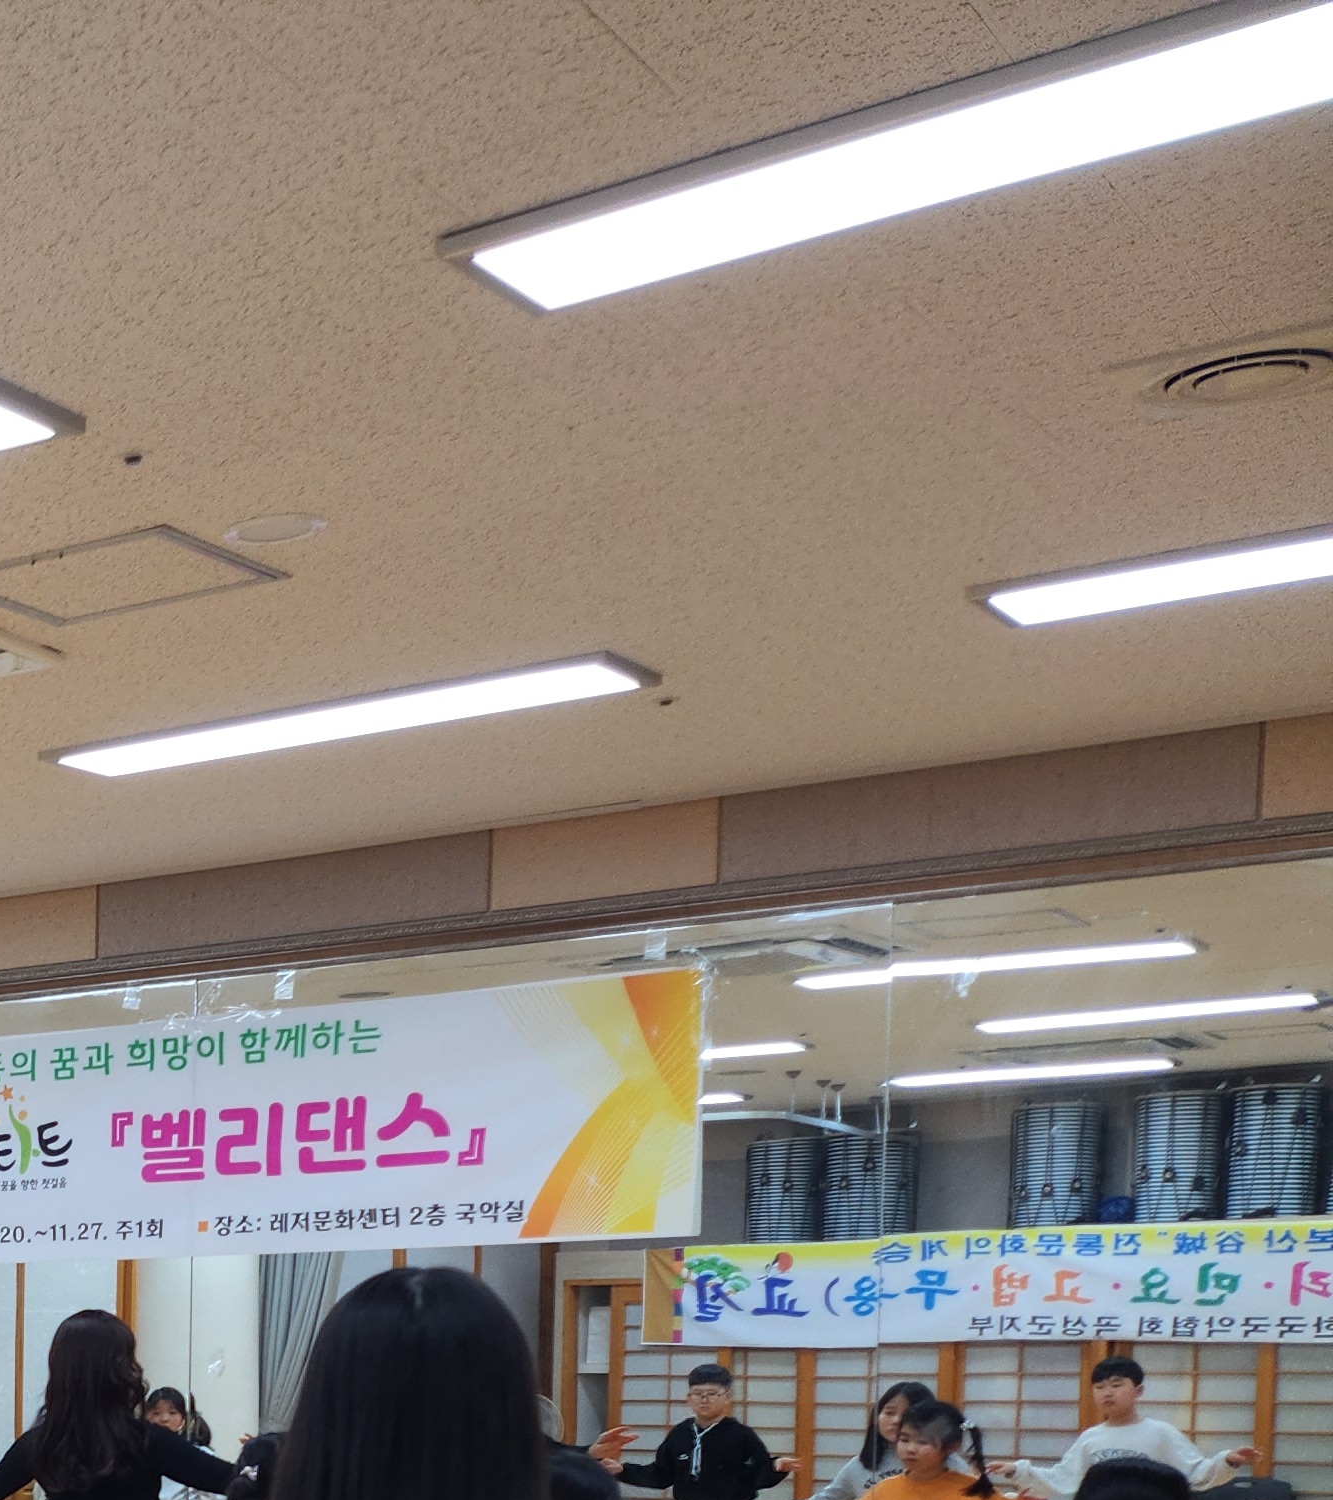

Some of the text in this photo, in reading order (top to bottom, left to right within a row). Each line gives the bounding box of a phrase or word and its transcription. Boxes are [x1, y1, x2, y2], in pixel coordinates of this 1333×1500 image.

[50, 1042, 114, 1081] 꿈과
[126, 1031, 225, 1072] 희망이
[239, 1019, 382, 1065] 함께하는
[115, 1218, 164, 1240] 주1회
[213, 1199, 526, 1237] 장소: 레저문화센터 2층 국악실
